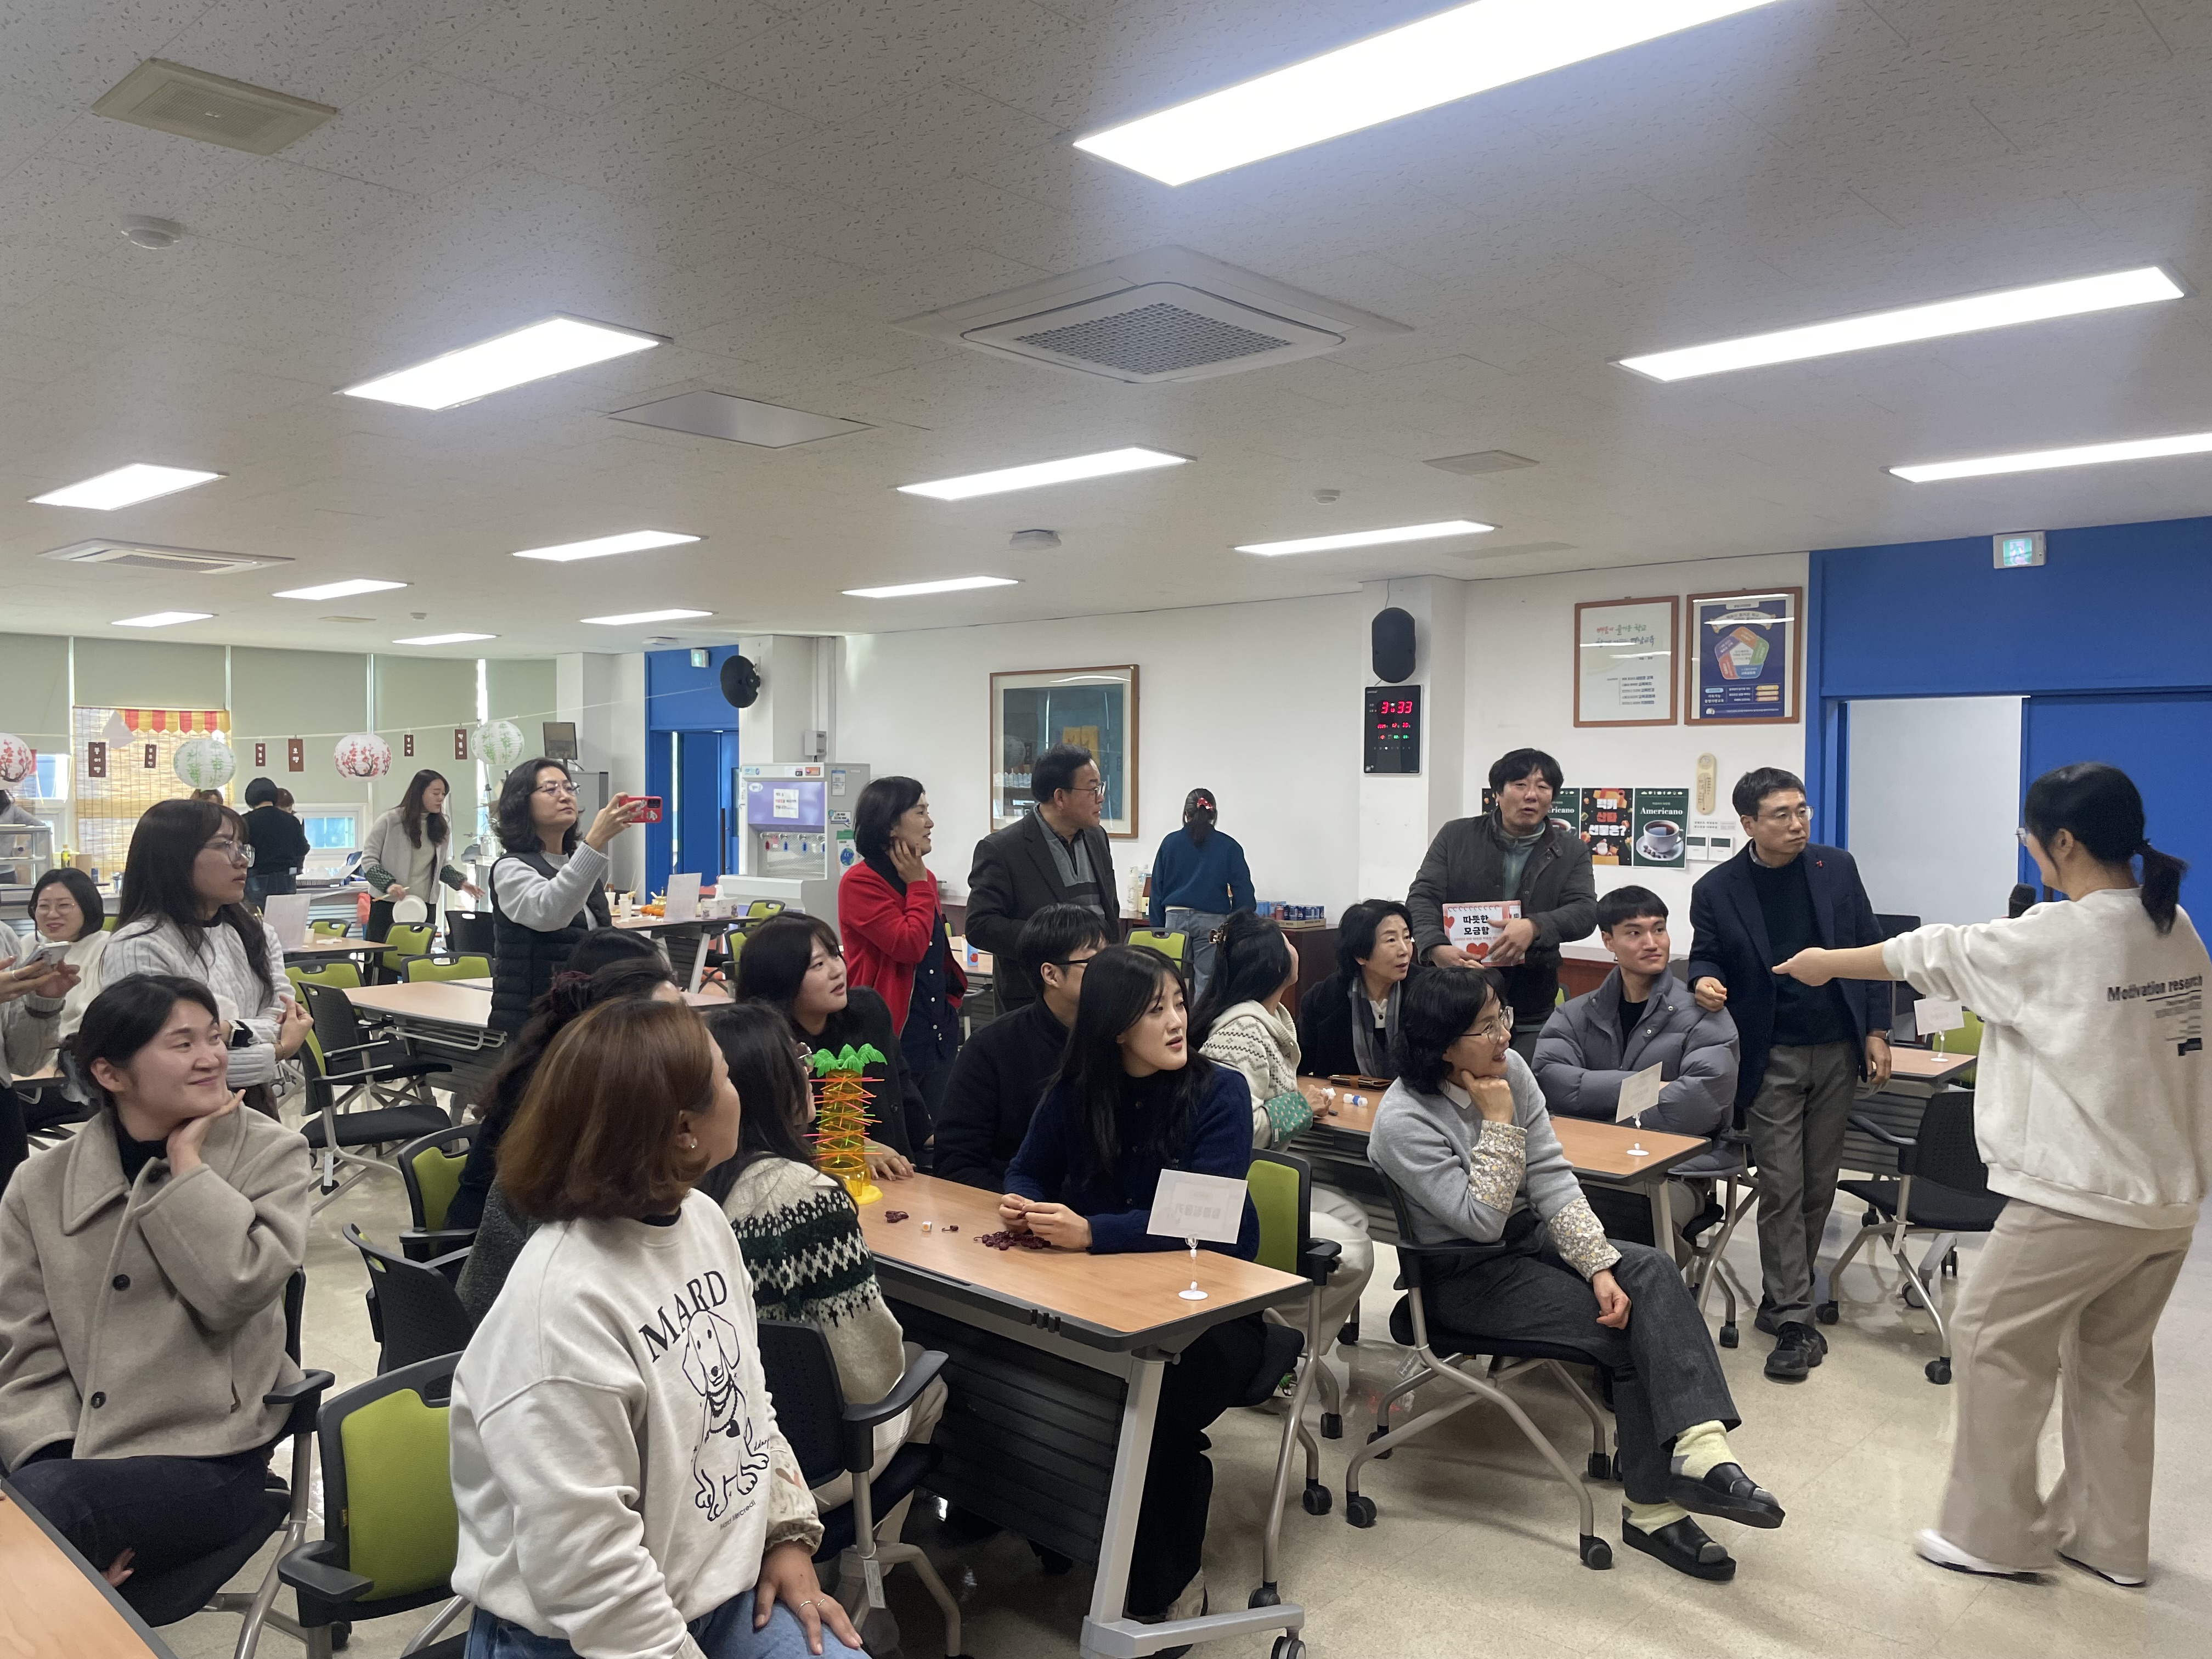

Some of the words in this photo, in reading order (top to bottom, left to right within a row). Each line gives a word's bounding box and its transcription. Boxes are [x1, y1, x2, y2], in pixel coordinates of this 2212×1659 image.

[1381, 701, 1413, 714] 3:33
[1596, 799, 1617, 809] 럭키
[1640, 806, 1683, 815] Americano
[1596, 812, 1617, 823] 산타
[1589, 825, 1627, 836] 선물은?
[1463, 915, 1489, 924] 따뜻한
[1464, 926, 1490, 935] 모금함
[2107, 981, 2166, 1001] Motivation
[639, 1271, 727, 1363] MARD
